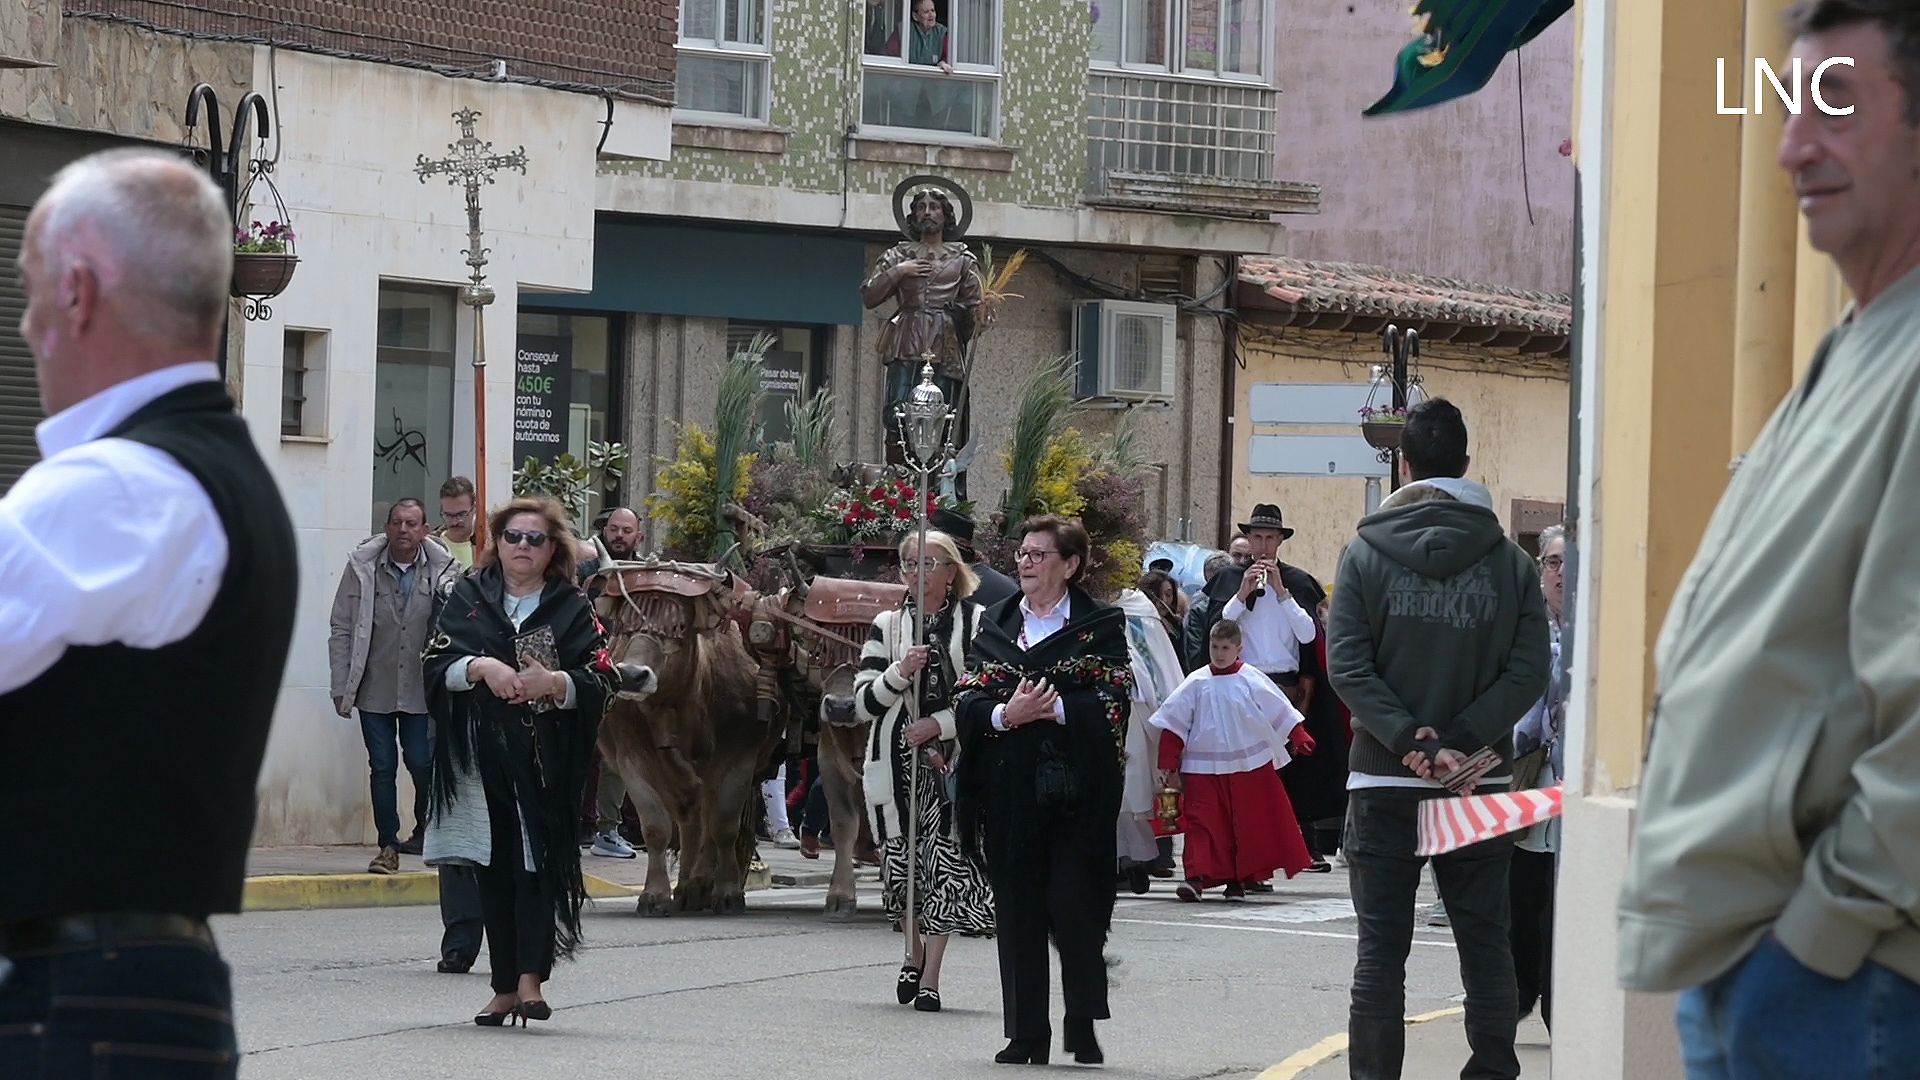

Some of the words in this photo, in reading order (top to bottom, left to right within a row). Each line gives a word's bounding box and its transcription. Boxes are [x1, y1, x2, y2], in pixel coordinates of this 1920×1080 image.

[517, 349, 559, 365] Conseguir
[517, 362, 541, 374] hasta
[517, 375, 555, 394] 450€
[516, 395, 532, 405] con
[532, 395, 542, 405] tu
[516, 405, 545, 418] nómina
[546, 409, 552, 418] o
[515, 419, 539, 430] cuota
[540, 419, 550, 430] de
[515, 430, 560, 443] autónomos
[1386, 590, 1498, 622] BROOKLYN
